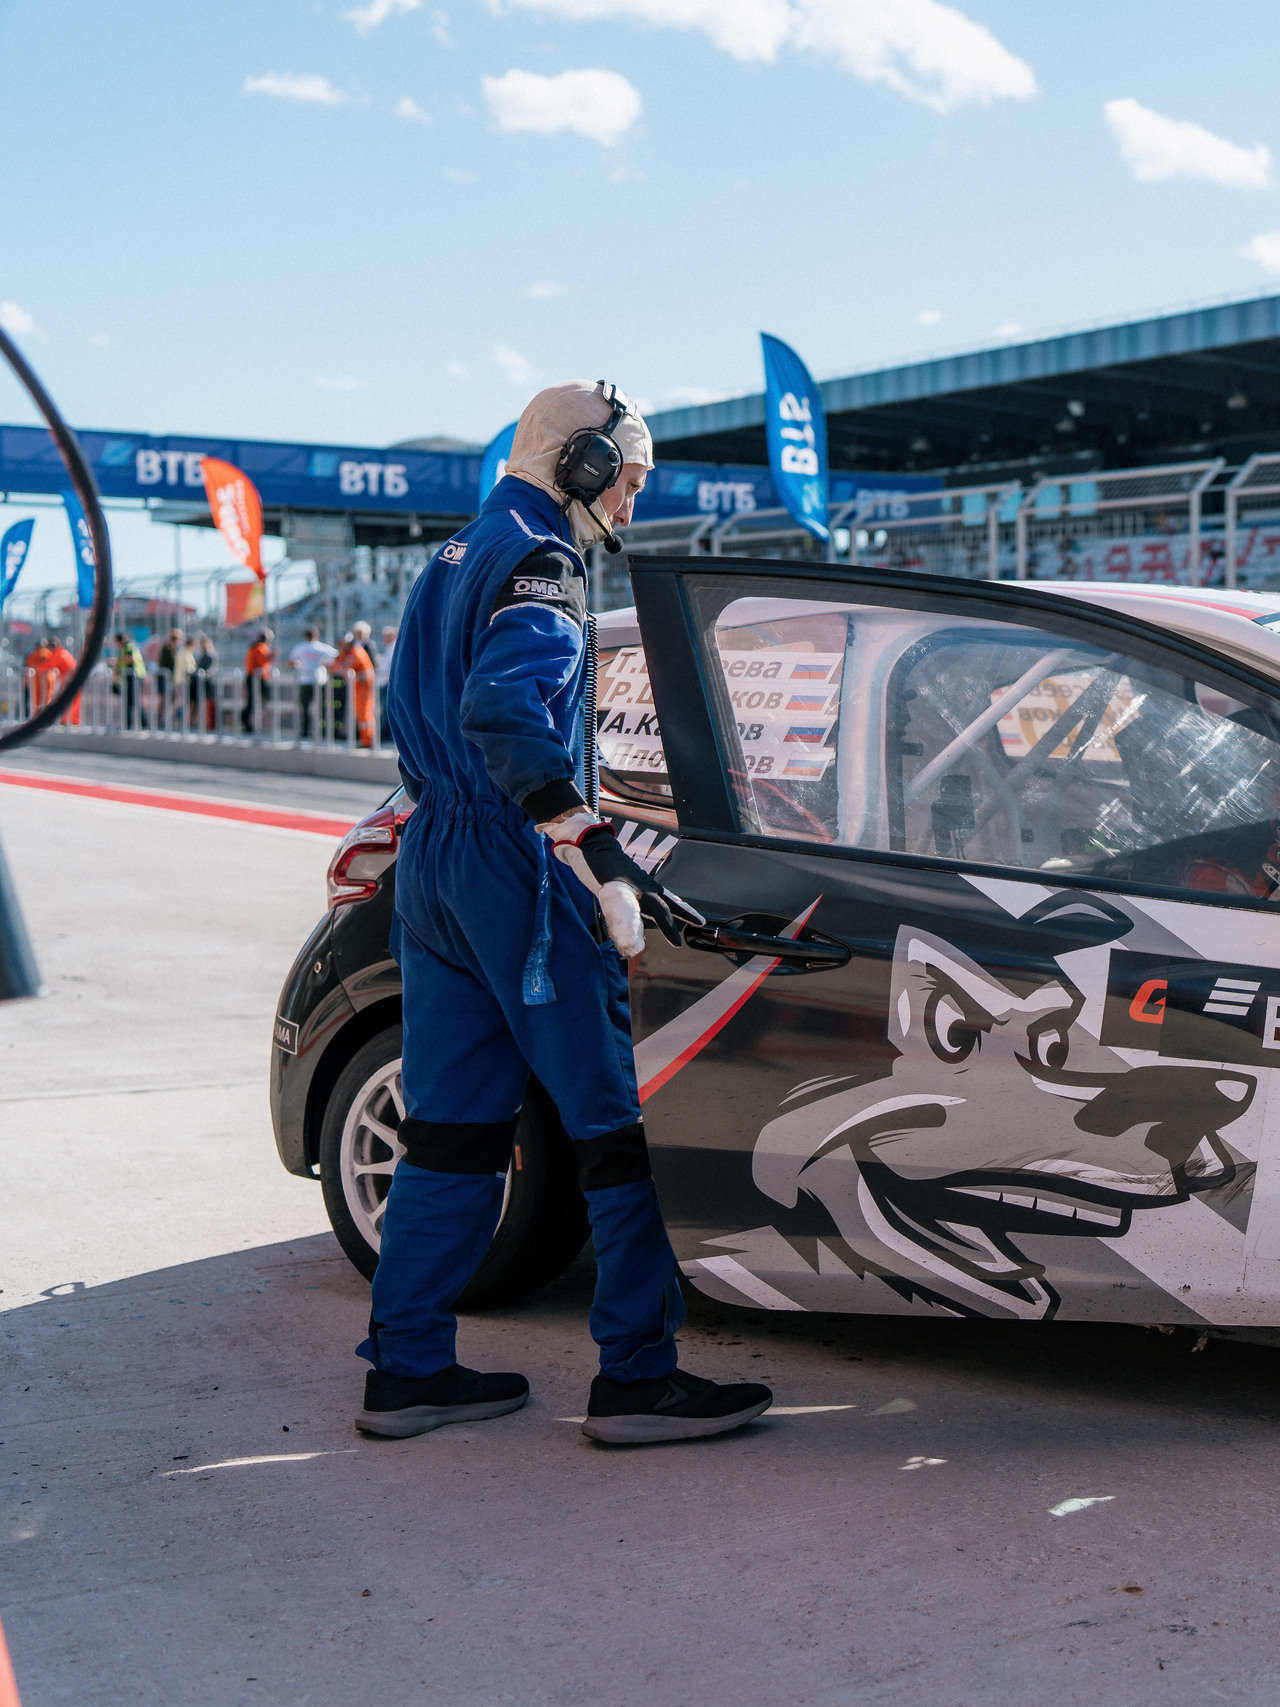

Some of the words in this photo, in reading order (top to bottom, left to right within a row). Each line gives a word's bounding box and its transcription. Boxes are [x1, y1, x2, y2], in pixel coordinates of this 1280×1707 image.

[136, 449, 206, 487] ВТБ
[339, 461, 409, 497] ВТБ
[698, 480, 757, 513] ВТБ
[514, 579, 560, 597] OMP
